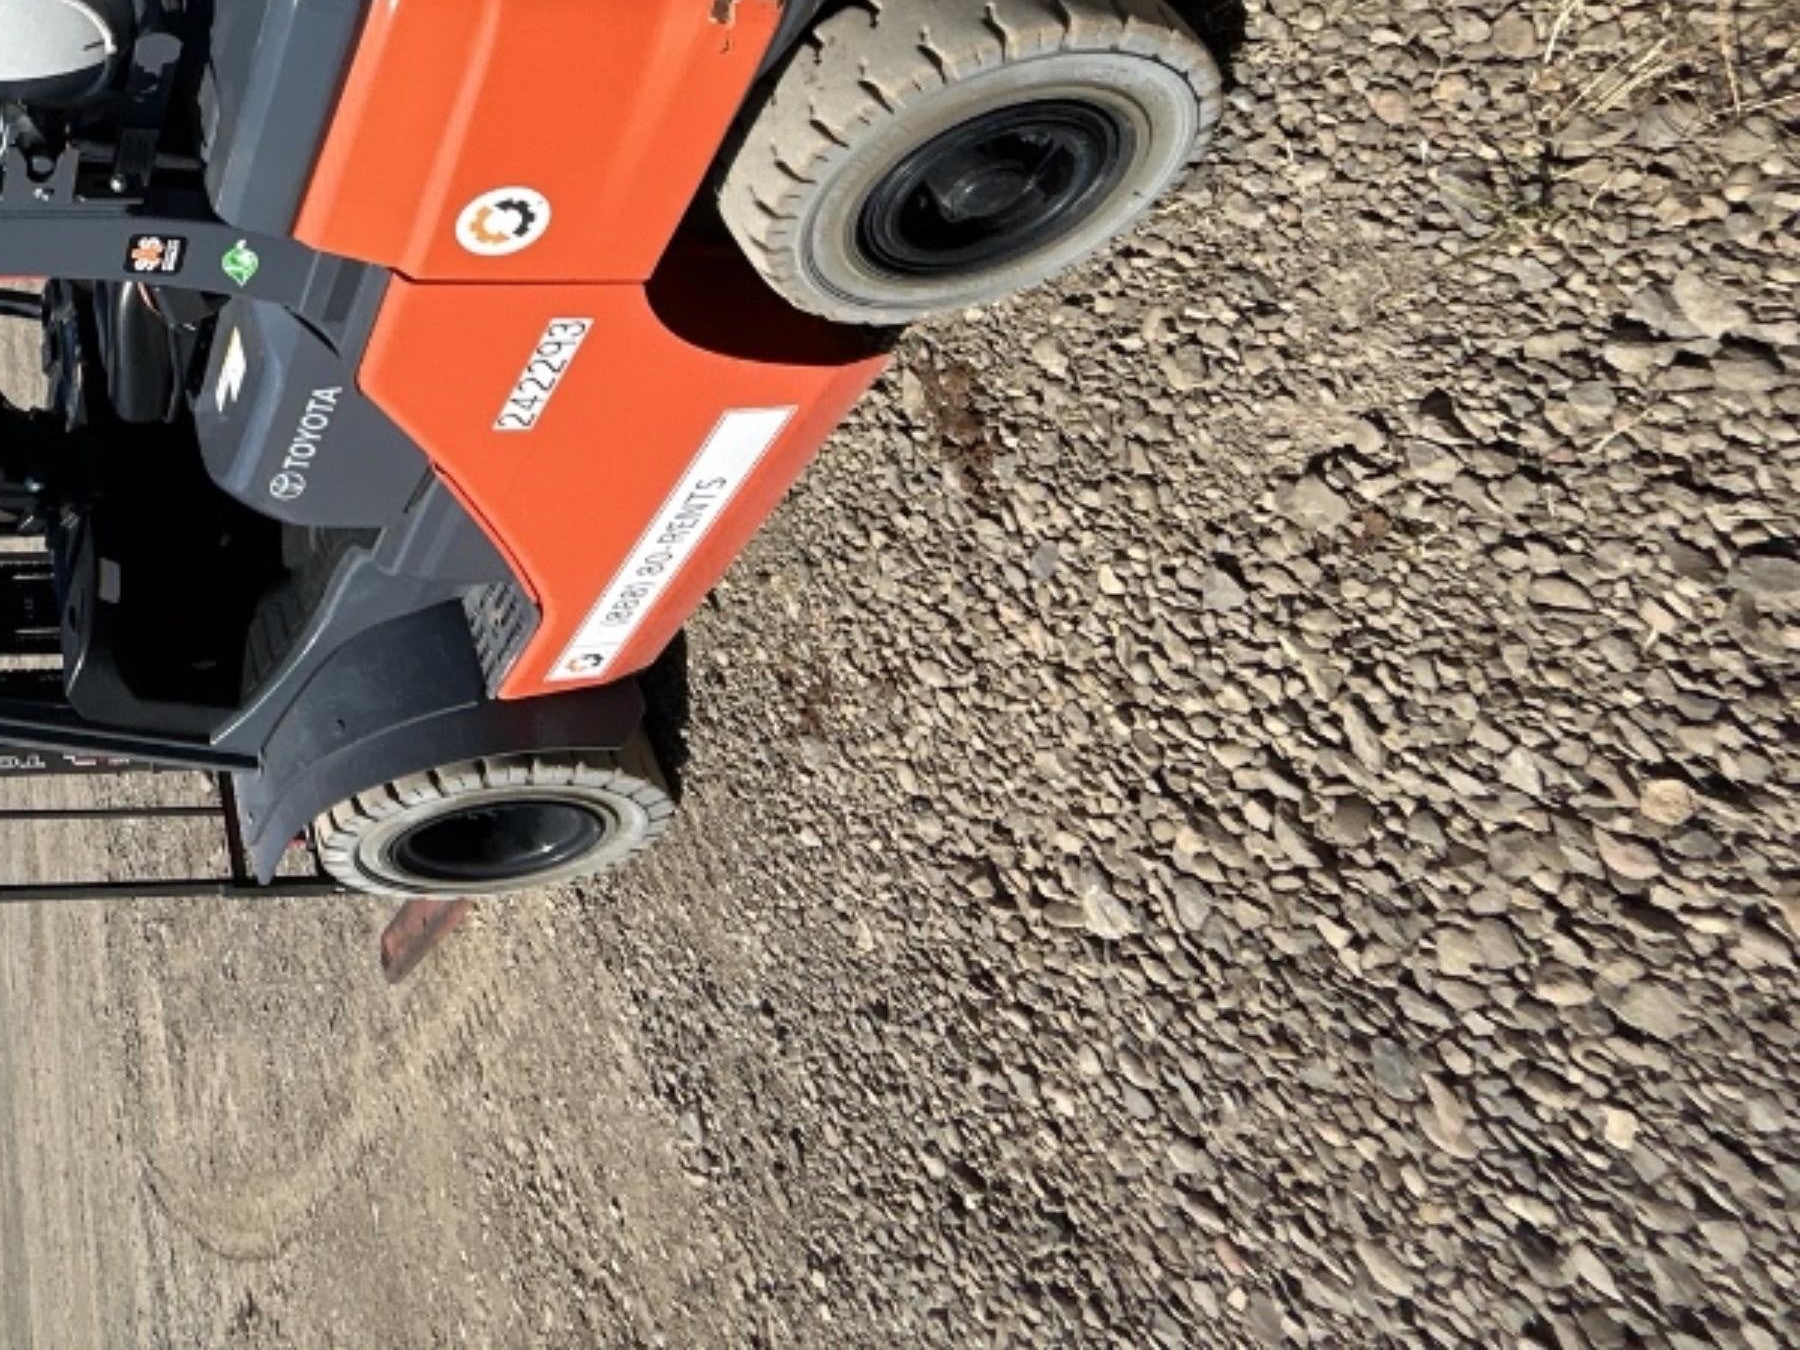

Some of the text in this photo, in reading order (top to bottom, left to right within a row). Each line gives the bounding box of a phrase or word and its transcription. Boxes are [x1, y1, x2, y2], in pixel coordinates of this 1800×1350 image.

[496, 321, 585, 427] 242293
[282, 386, 343, 470] TOYOTA
[599, 476, 728, 627] (888) 80-RENTS
